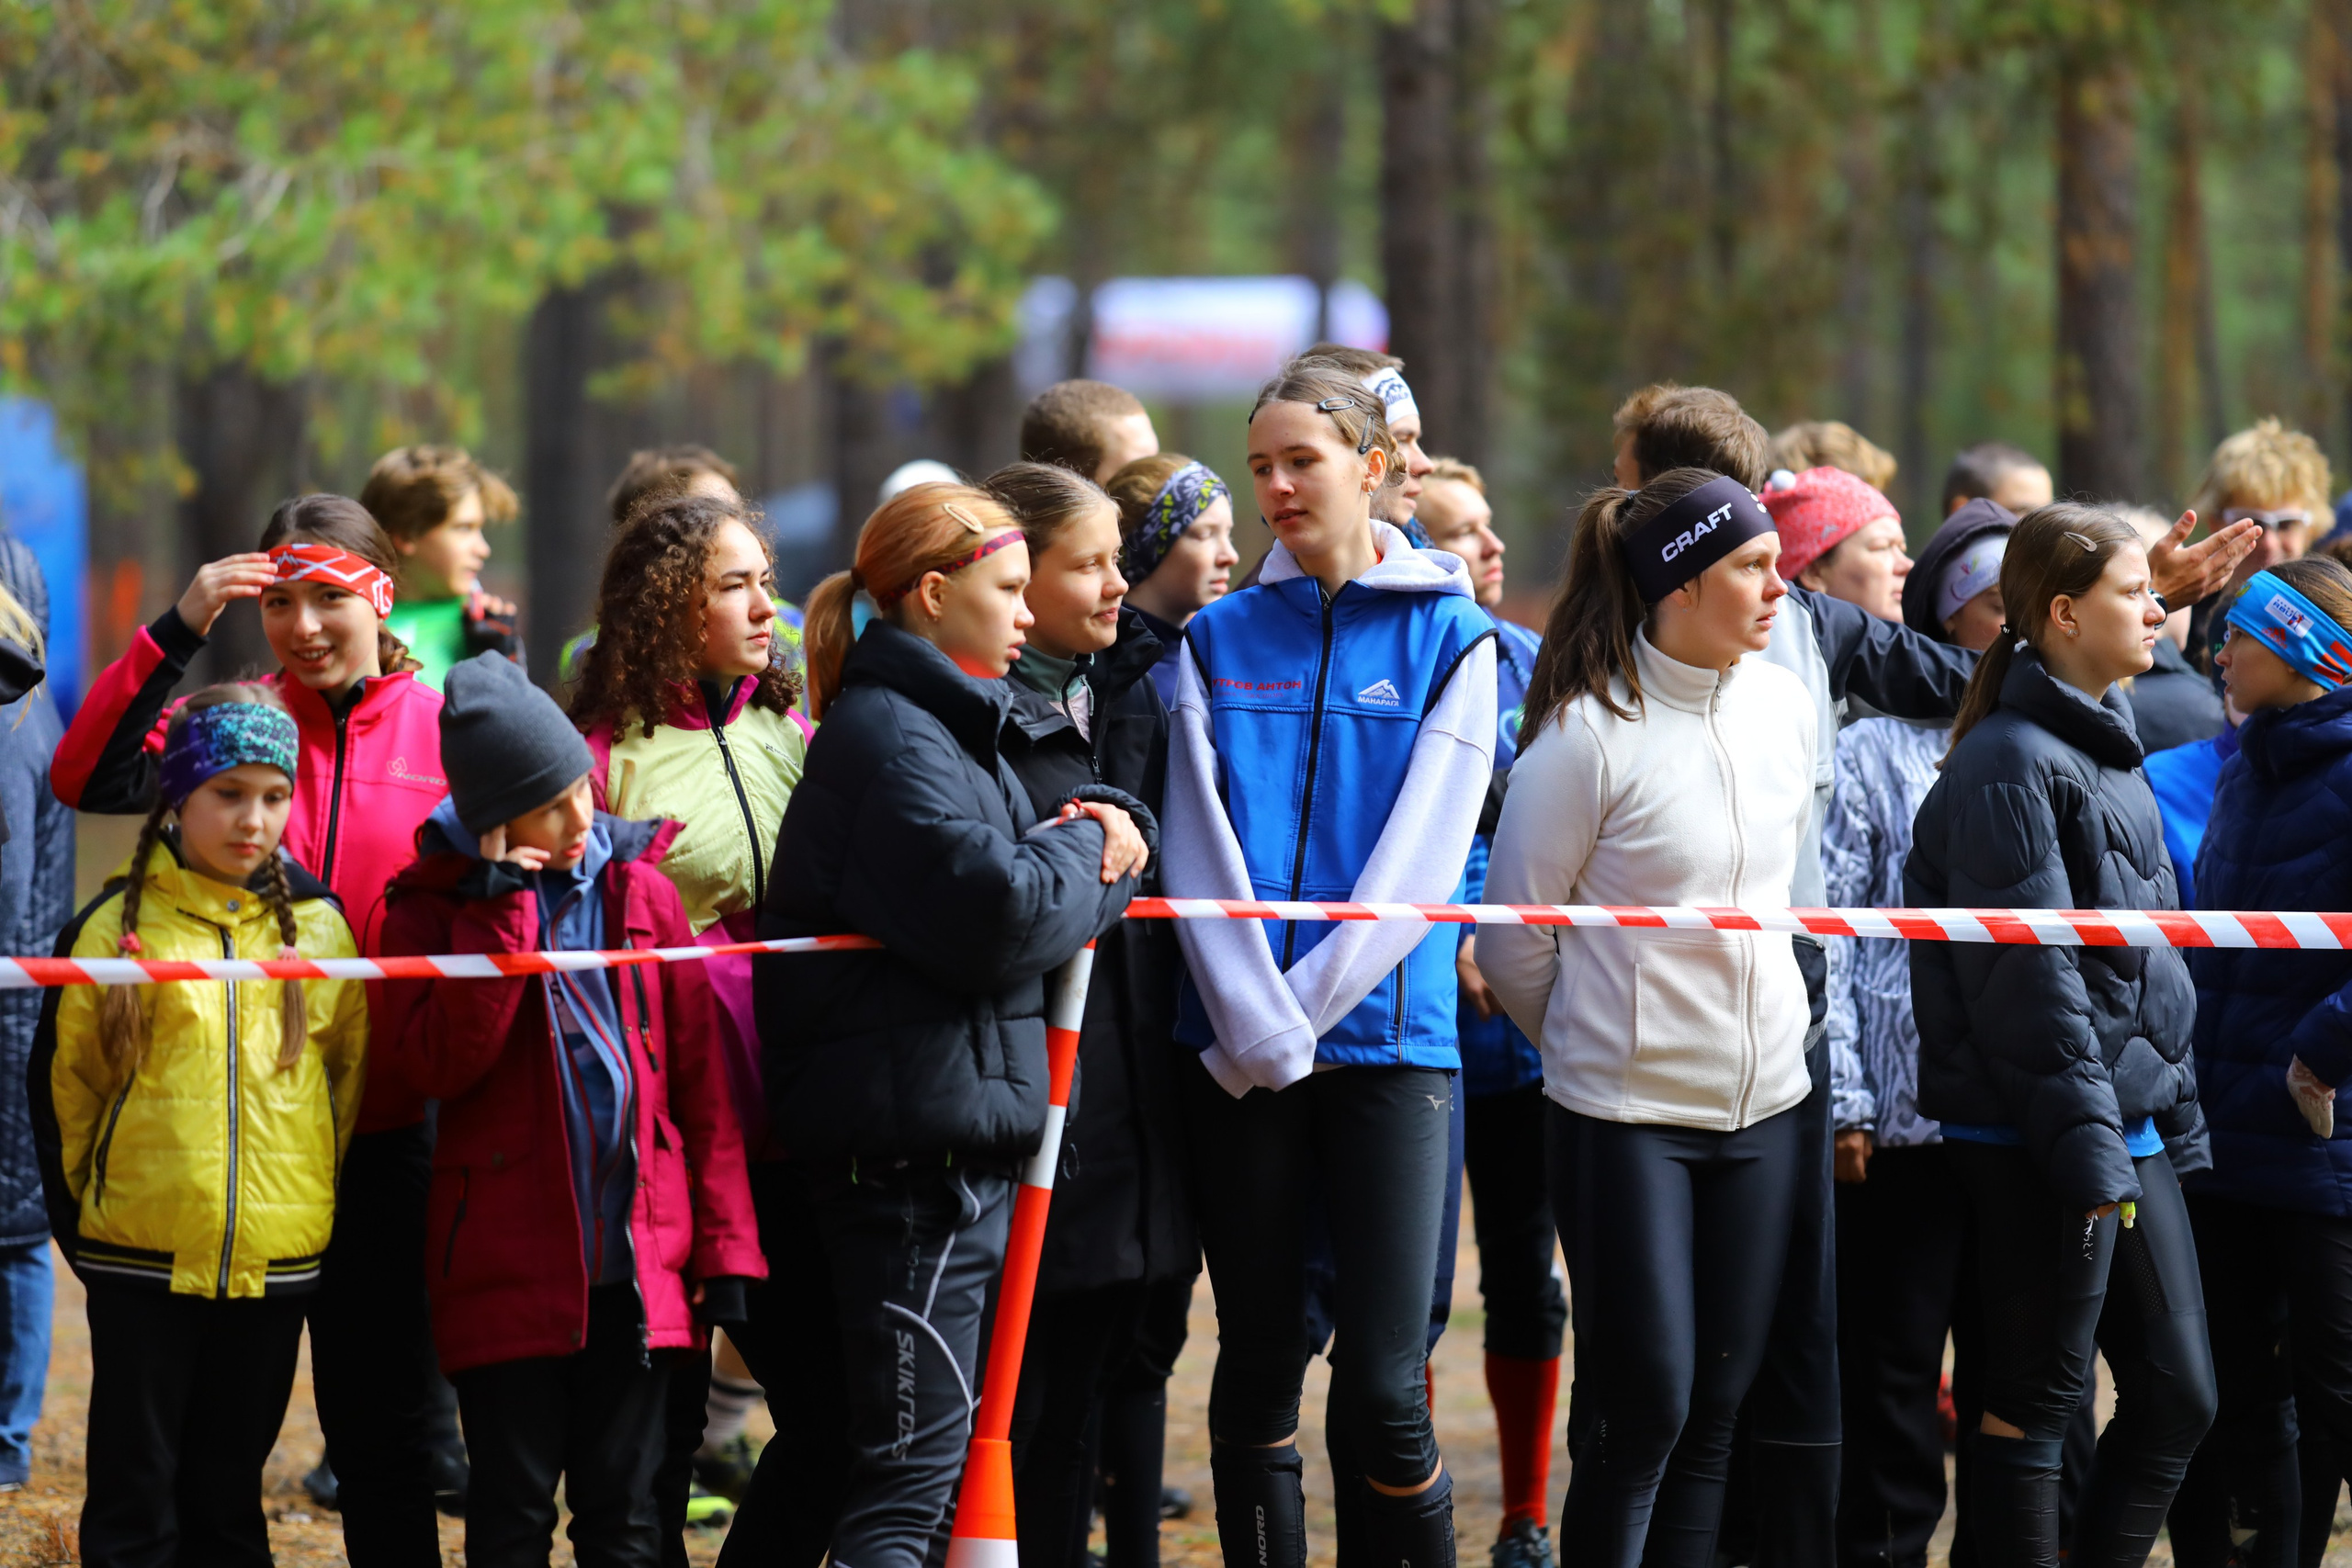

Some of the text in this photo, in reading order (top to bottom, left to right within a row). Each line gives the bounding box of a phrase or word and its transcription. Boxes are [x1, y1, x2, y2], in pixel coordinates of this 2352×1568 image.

[1661, 502, 1732, 562] CRAFT
[1256, 681, 1302, 691] АНТОН
[1358, 696, 1399, 707] МАНАРАГА
[397, 773, 447, 786] NORD
[1256, 1505, 1268, 1566] NORD
